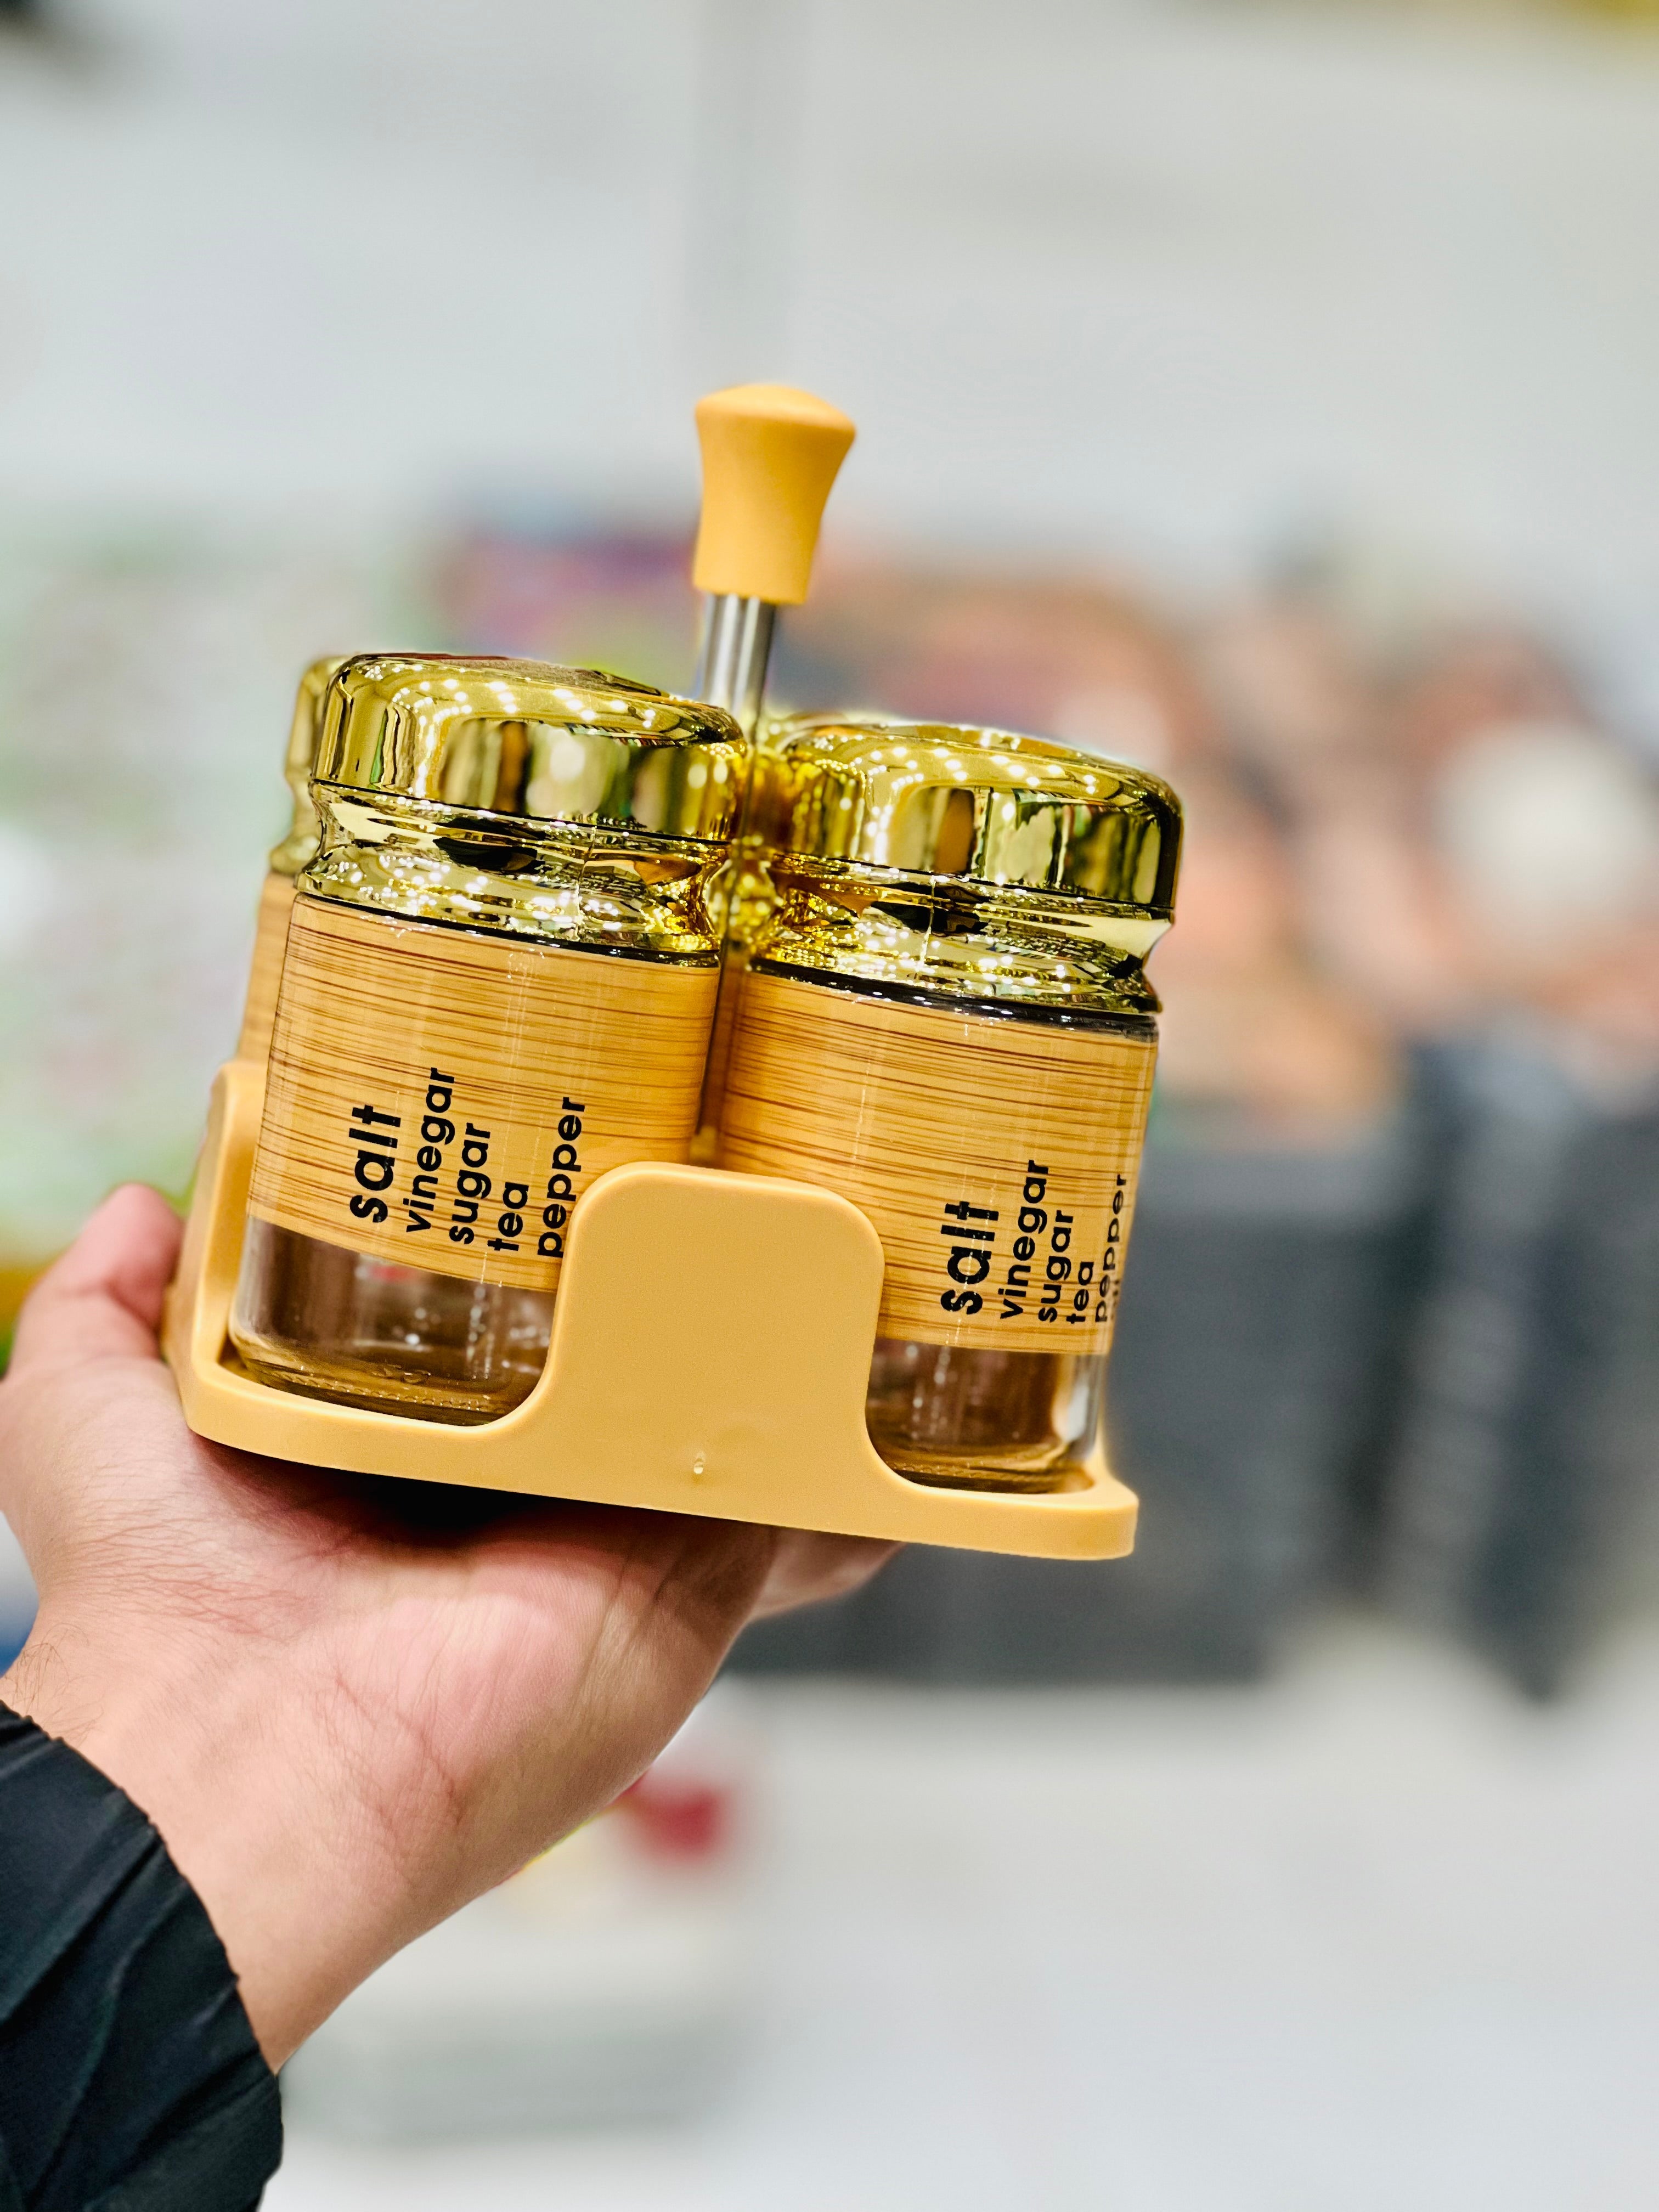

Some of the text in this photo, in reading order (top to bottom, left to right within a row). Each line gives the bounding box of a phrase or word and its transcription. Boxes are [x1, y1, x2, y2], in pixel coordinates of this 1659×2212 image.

[349, 1105, 400, 1223] salt
[403, 1068, 455, 1232] vinegar
[449, 1123, 490, 1244] sugar
[538, 1097, 585, 1257] pepper
[488, 1182, 529, 1251] tea
[941, 1201, 998, 1314] salt
[998, 1160, 1048, 1319] vinegar
[1039, 1210, 1073, 1322] sugar
[1095, 1175, 1126, 1322] pepper
[1067, 1262, 1094, 1323] tea
